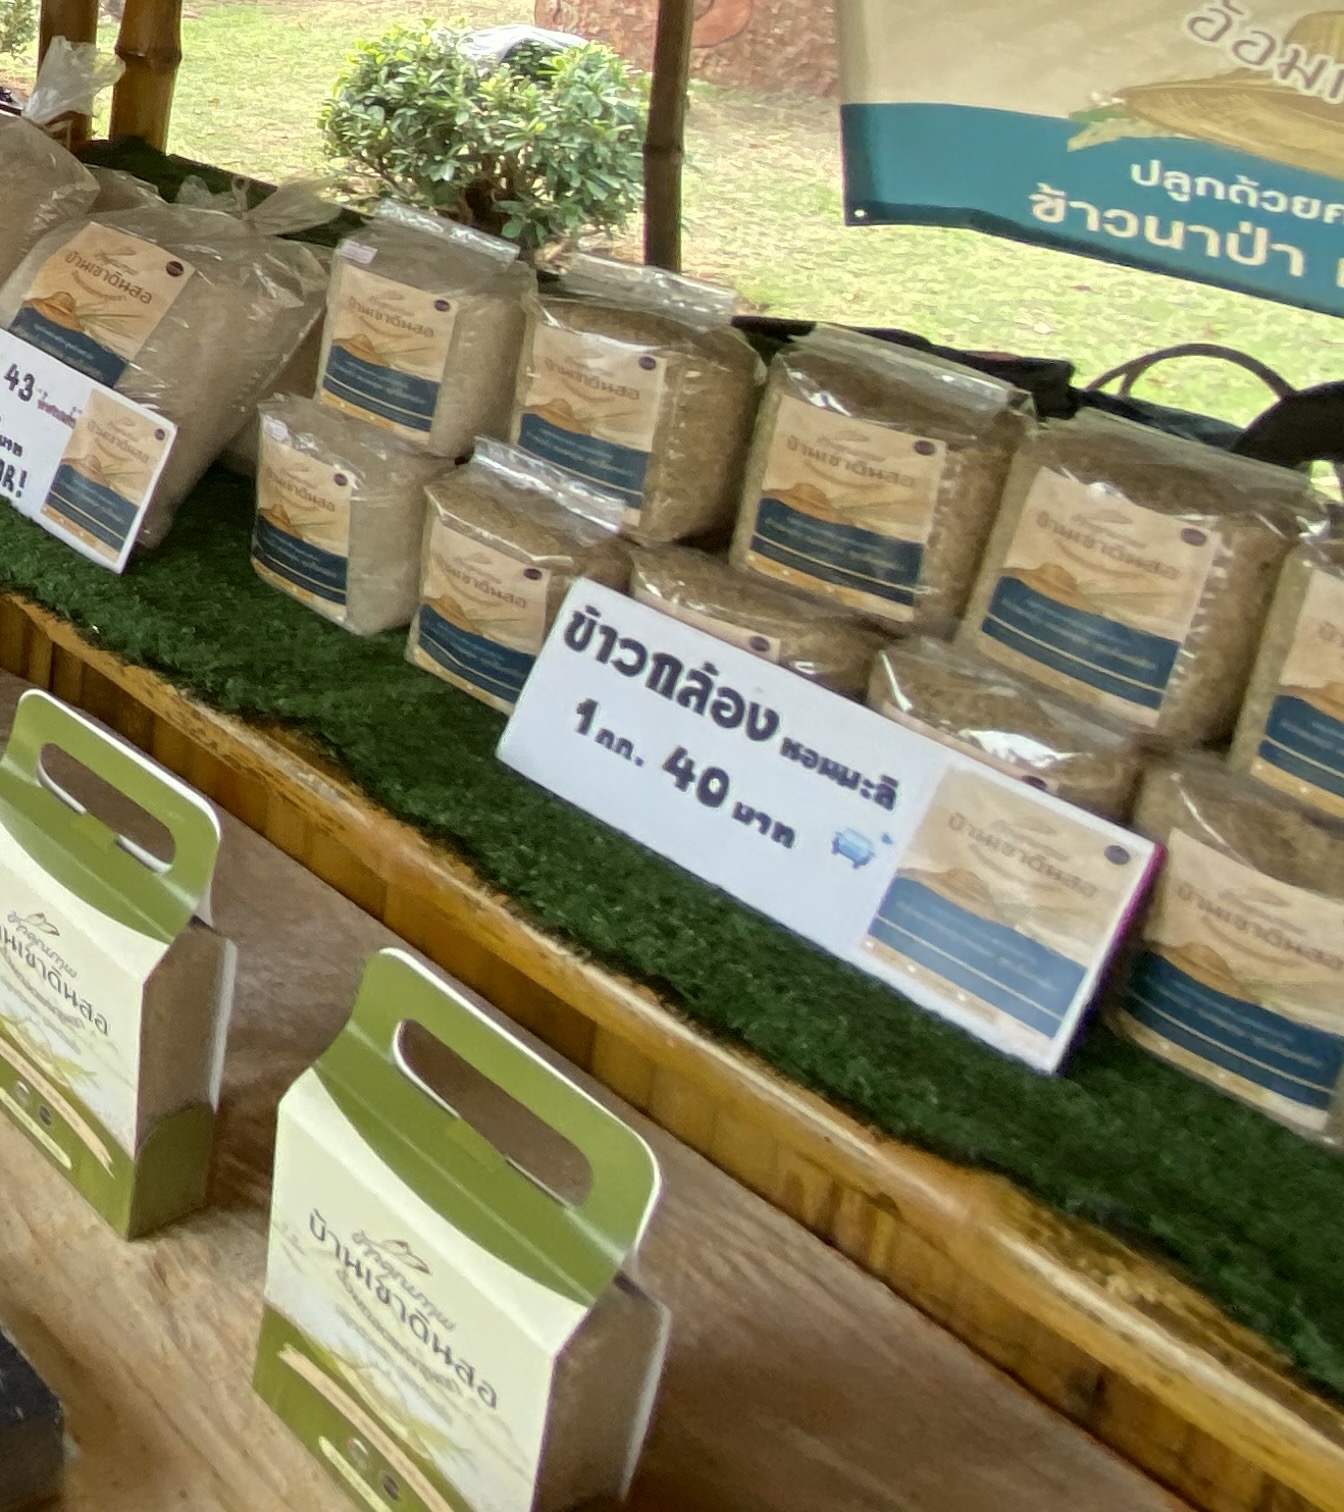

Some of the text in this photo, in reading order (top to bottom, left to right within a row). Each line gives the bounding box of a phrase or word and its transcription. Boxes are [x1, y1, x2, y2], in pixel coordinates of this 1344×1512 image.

[4, 363, 36, 402] 43
[563, 604, 901, 813] ข้าวกล้อง หอมมะลิ
[661, 745, 732, 809] 40
[732, 800, 798, 852] บาท
[309, 1207, 498, 1409] บ้านเขาดินสอ
